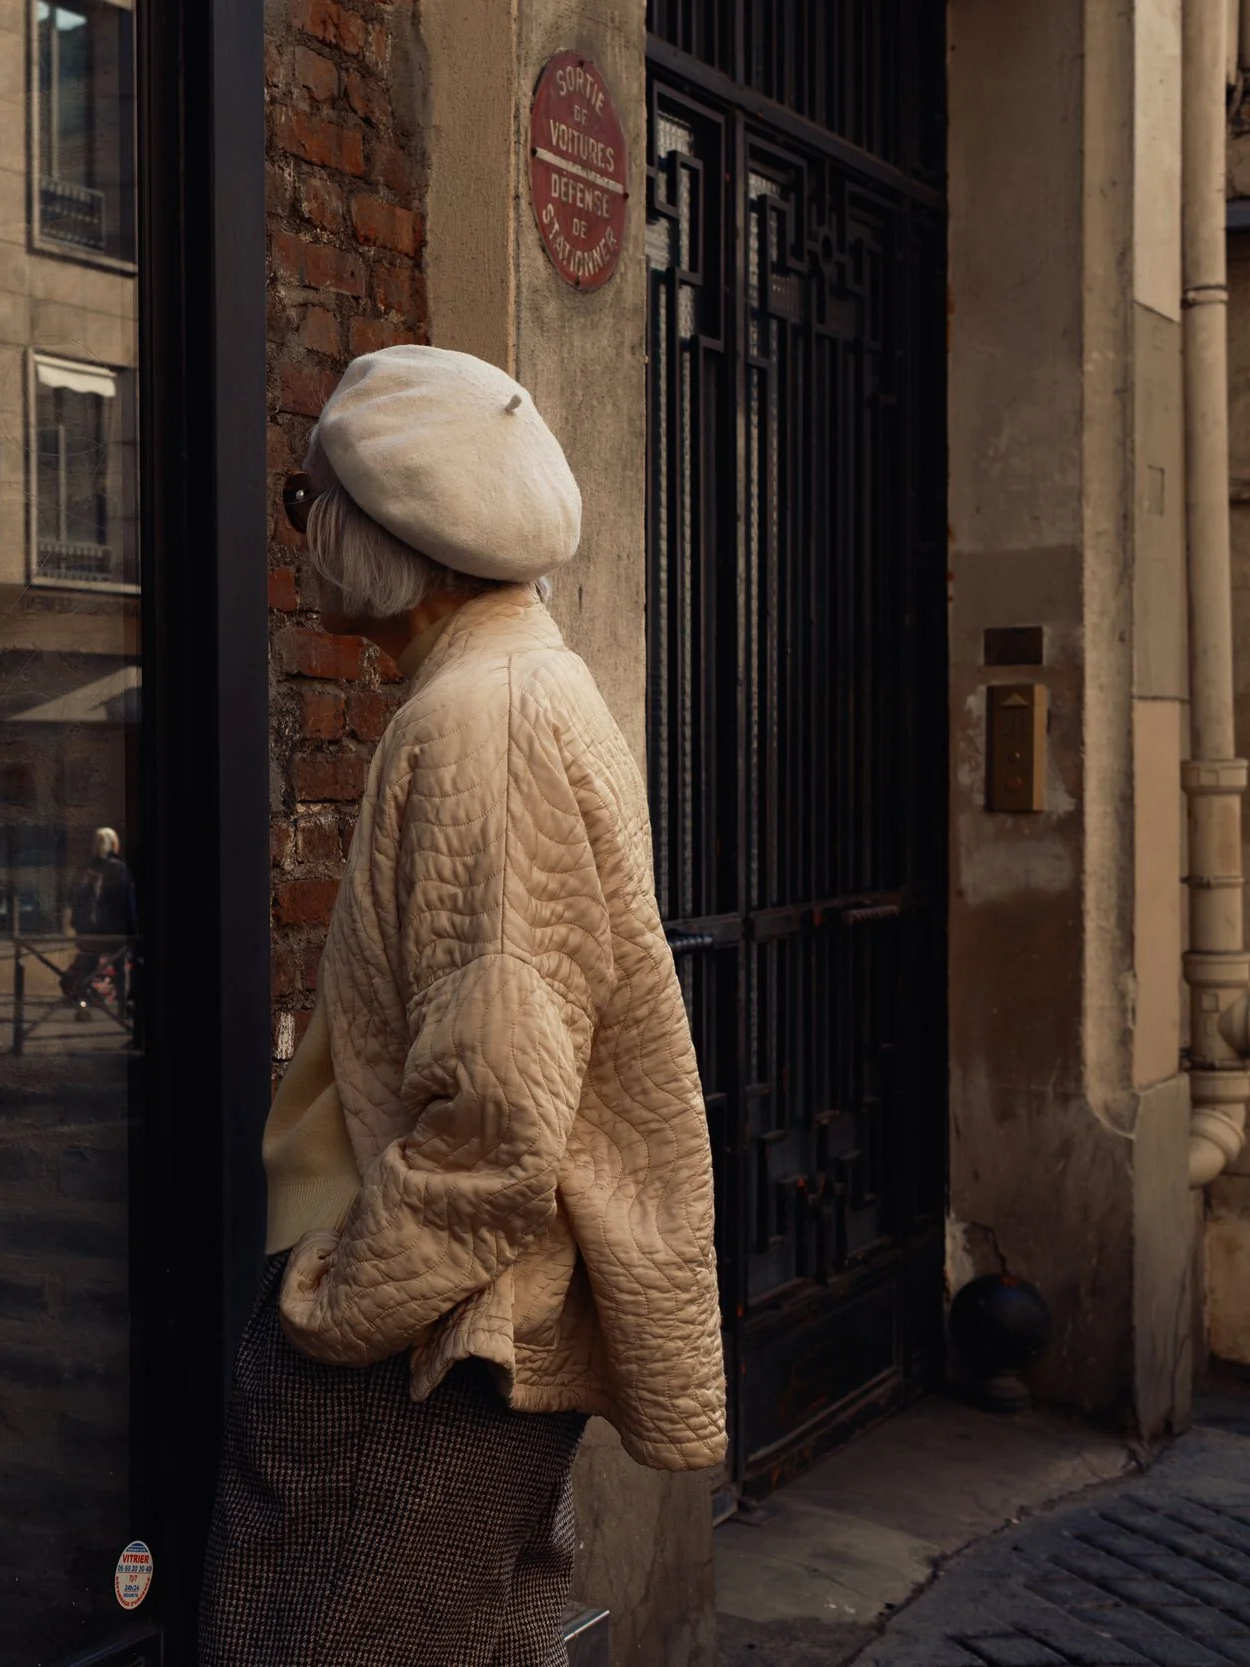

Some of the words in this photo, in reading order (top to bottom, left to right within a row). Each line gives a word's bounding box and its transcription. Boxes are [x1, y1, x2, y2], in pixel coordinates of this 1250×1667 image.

[556, 65, 606, 117] SORTIE
[574, 105, 588, 125] DE
[549, 119, 615, 173] VOITURES
[551, 170, 611, 218] DÉFENSE
[542, 203, 617, 277] STATIONNER
[572, 218, 588, 239] DE
[123, 1554, 149, 1564] VITRIER
